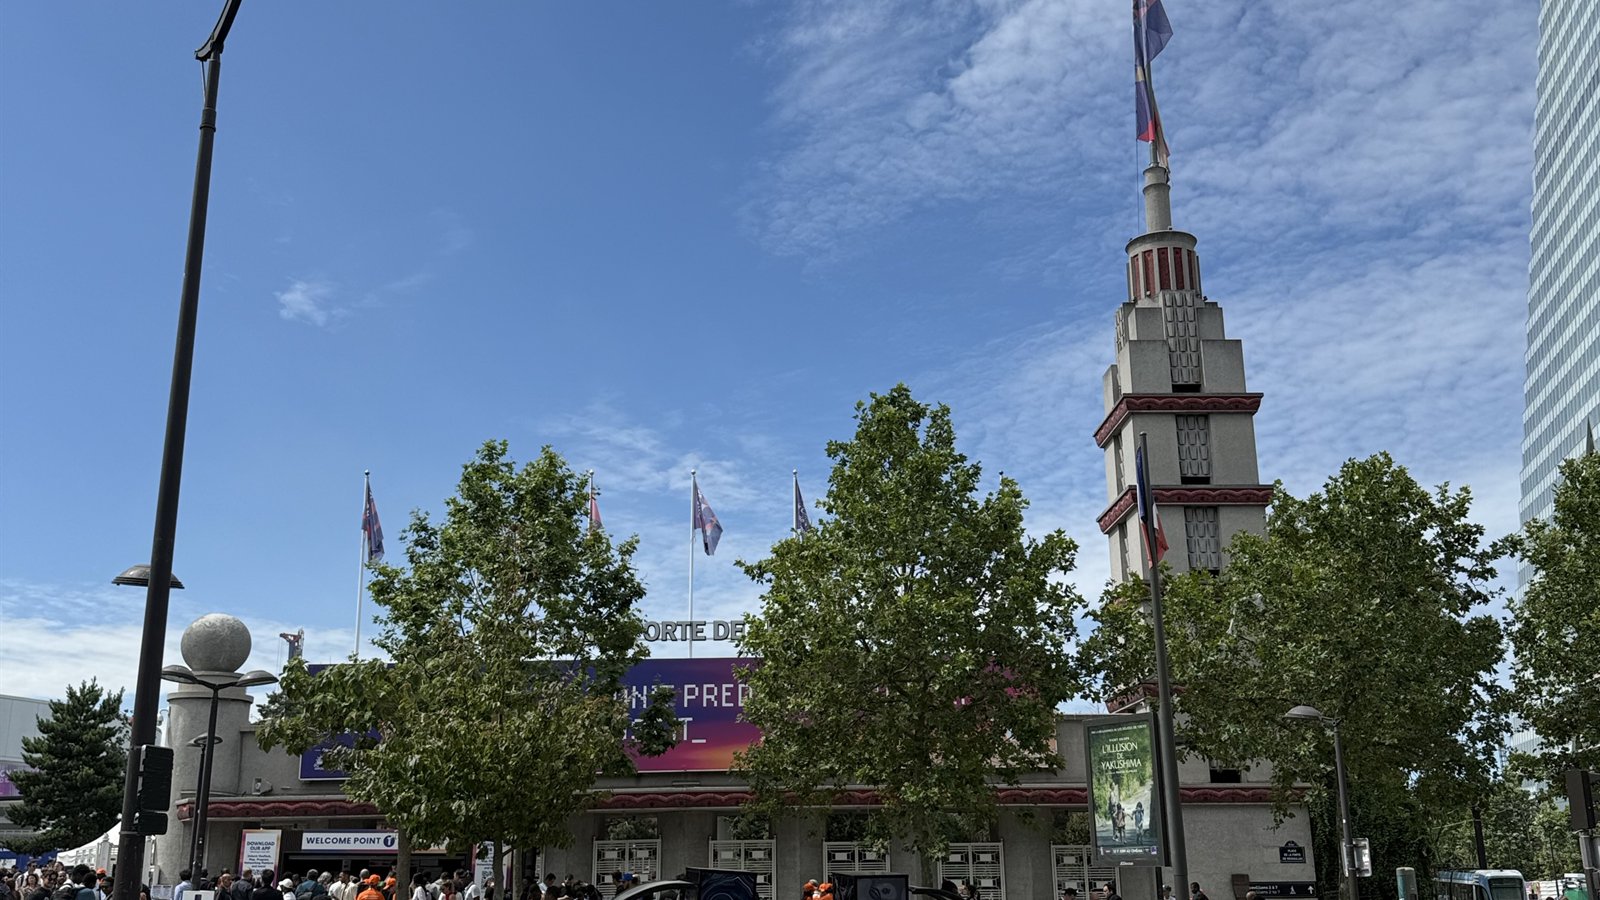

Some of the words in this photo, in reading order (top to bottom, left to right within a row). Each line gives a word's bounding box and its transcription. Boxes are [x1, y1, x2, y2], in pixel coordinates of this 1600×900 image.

[643, 620, 706, 642] ORTE
[683, 683, 753, 708] PRED
[1102, 742, 1138, 754] L'ILLUSION
[1101, 758, 1142, 770] YAKUSHIMA
[306, 836, 351, 845] WELCOME
[353, 836, 382, 845] POINT
